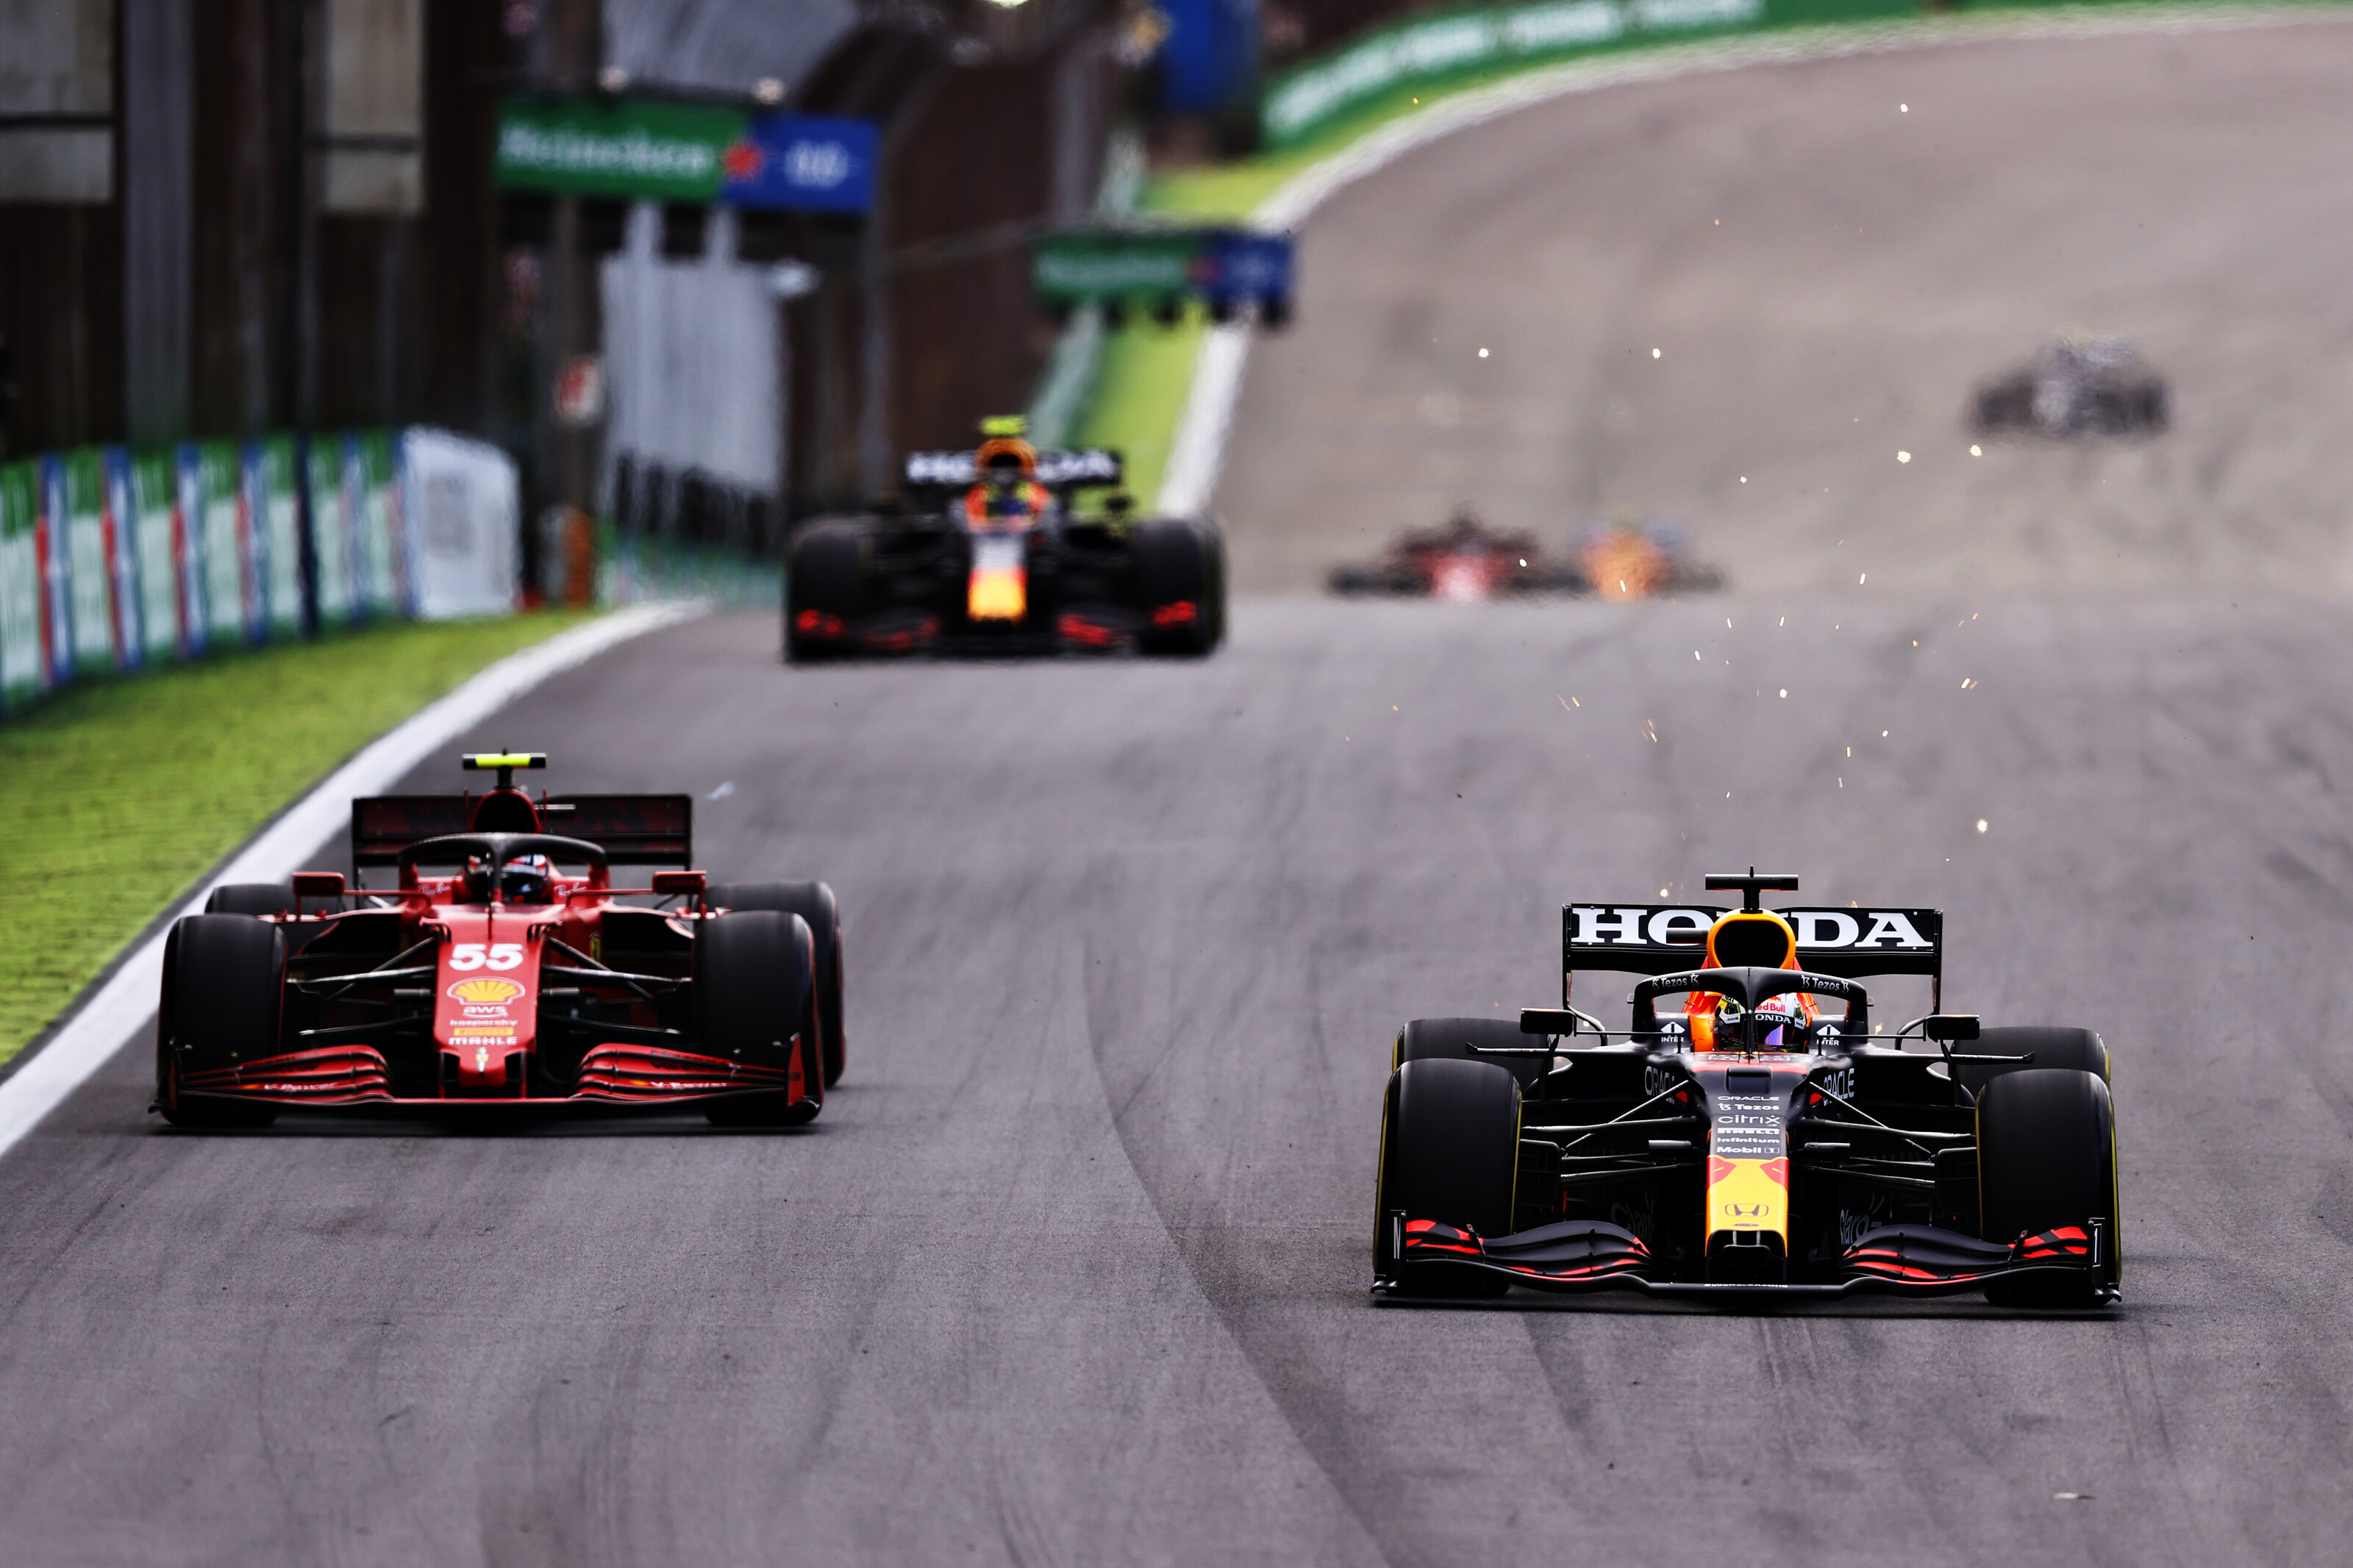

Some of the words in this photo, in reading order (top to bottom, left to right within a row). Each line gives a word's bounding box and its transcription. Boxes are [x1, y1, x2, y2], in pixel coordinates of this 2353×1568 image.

[1571, 908, 1934, 948] HODA
[449, 943, 524, 971] 55
[1661, 978, 1688, 988] Tezos
[1812, 978, 1840, 991] Tezos
[463, 1006, 507, 1014] aws
[1769, 1003, 1785, 1012] Bull
[449, 1019, 518, 1027] kaspersky
[1755, 1014, 1792, 1024] ONDA
